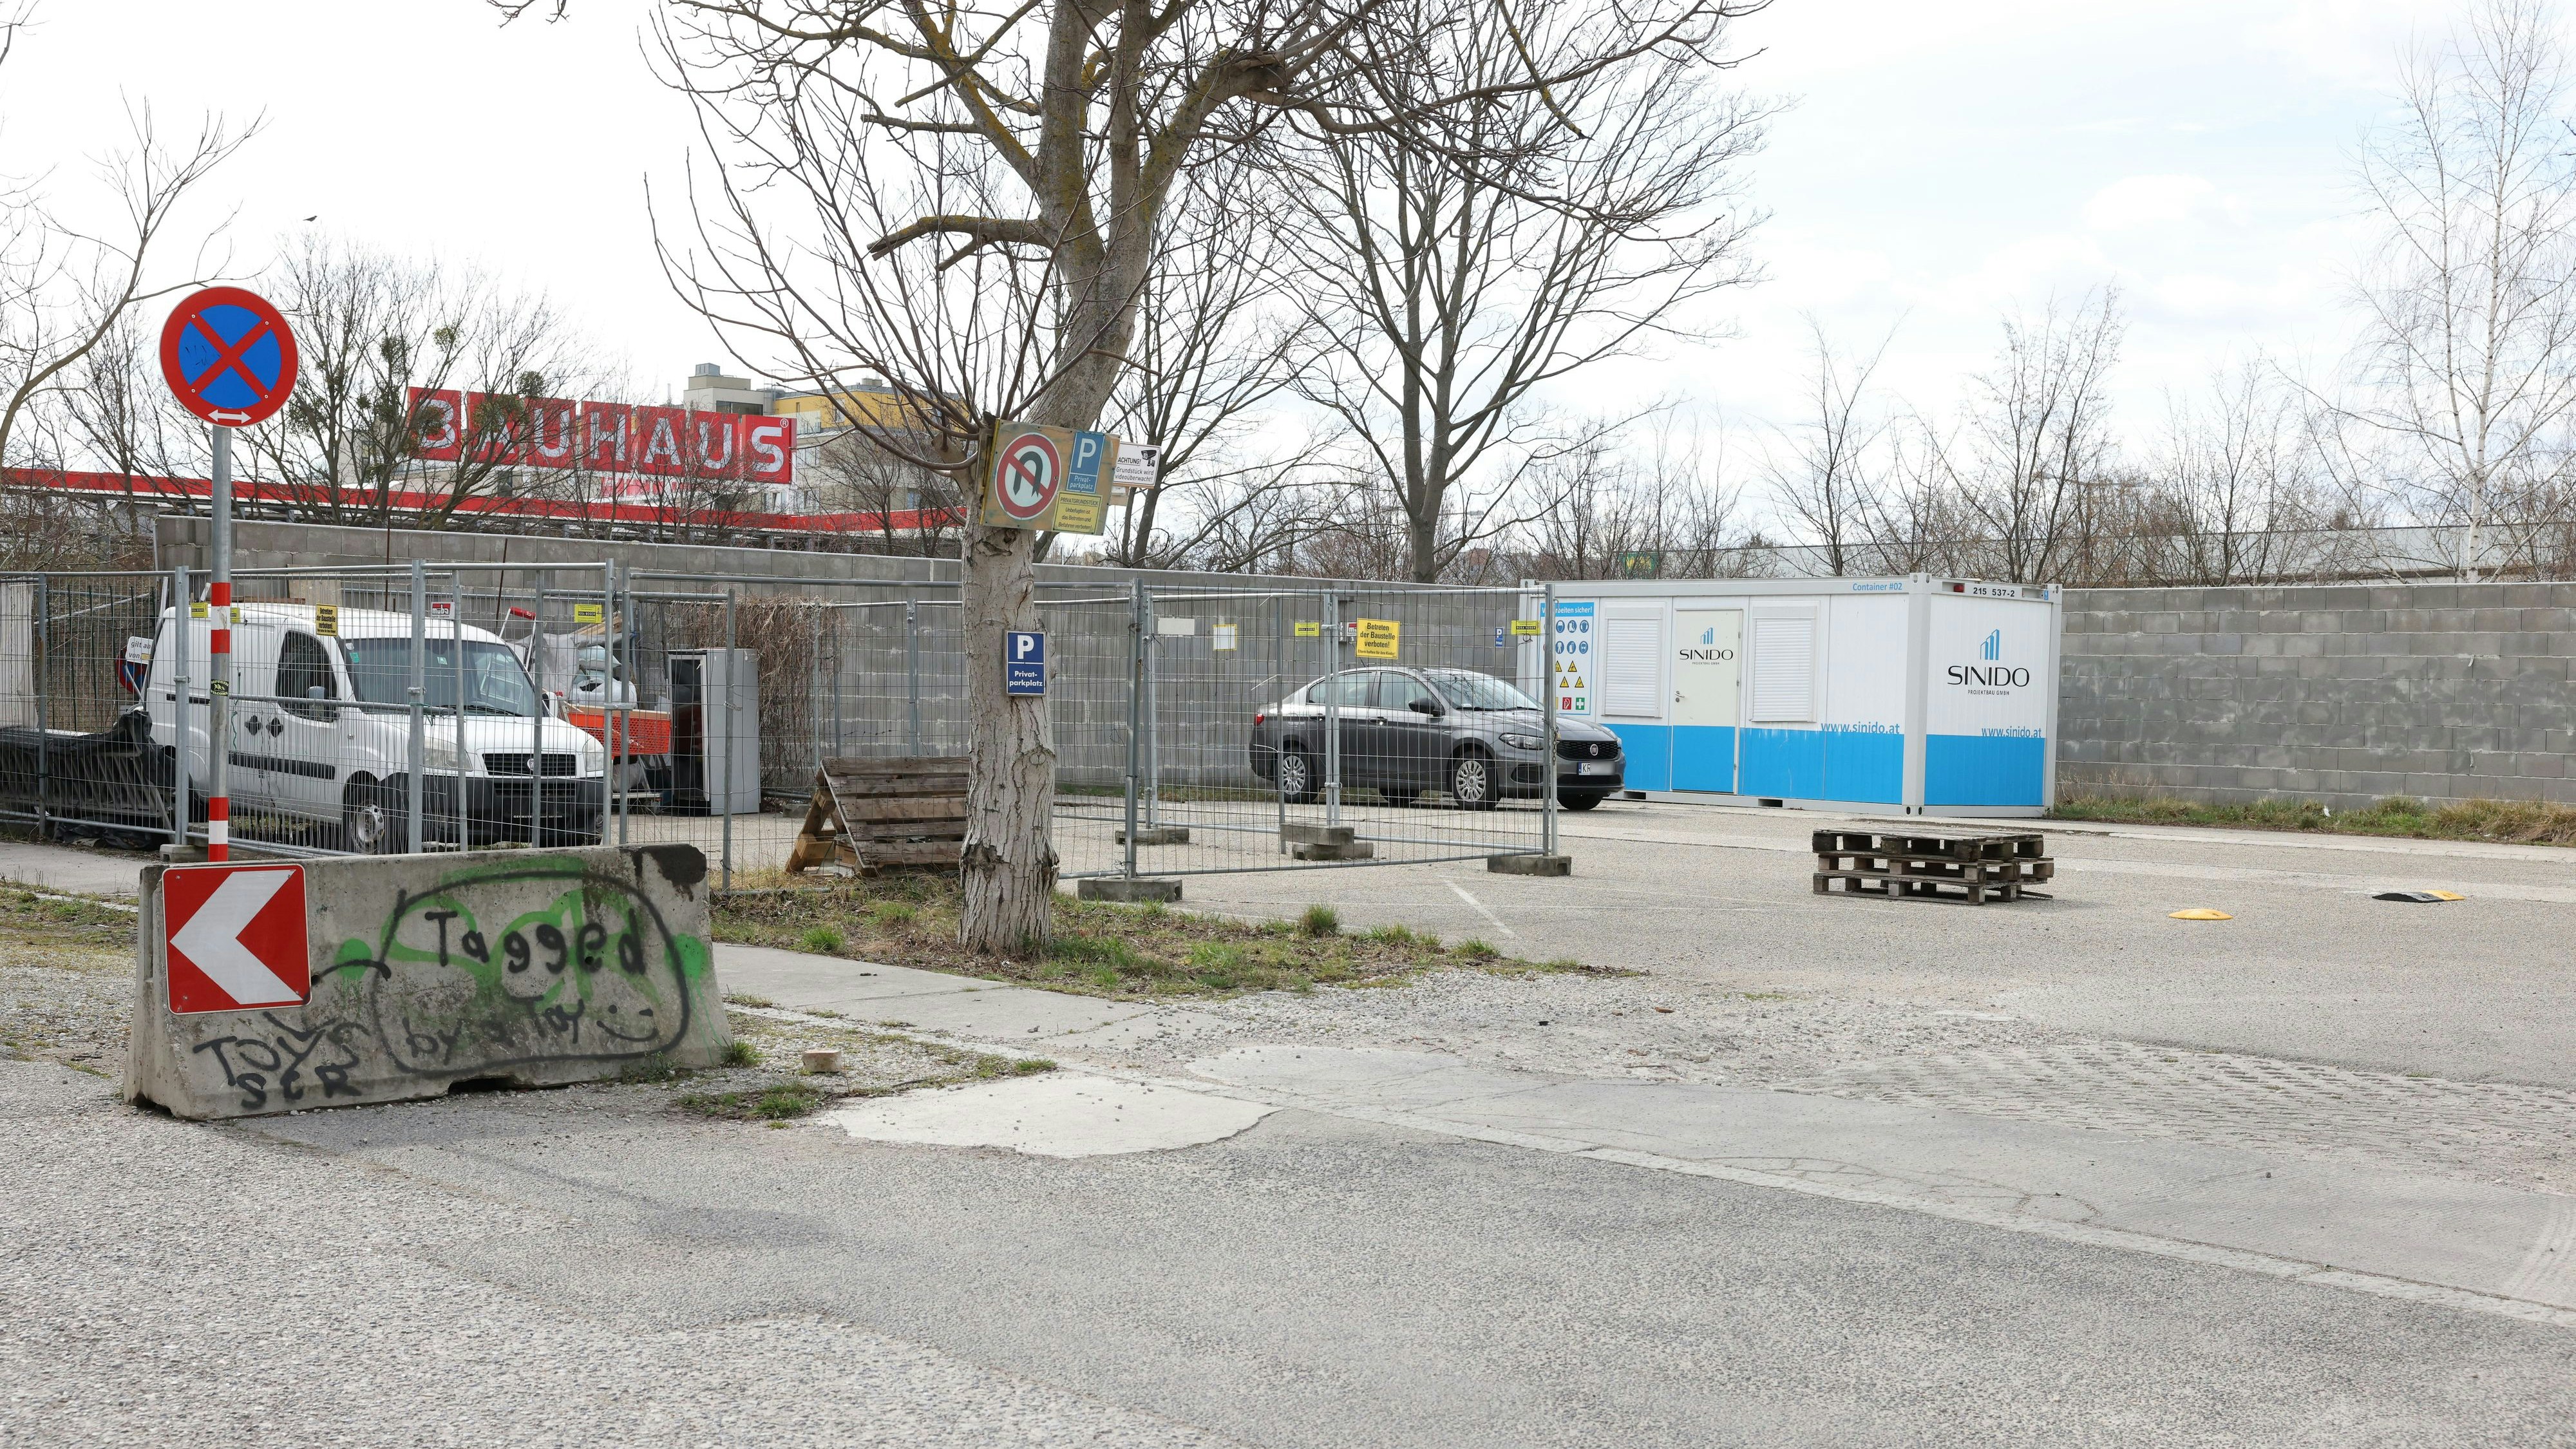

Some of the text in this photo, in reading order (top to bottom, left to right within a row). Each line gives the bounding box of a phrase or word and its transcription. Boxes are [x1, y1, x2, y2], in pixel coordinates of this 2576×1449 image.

[419, 399, 782, 473] BAUHAUS
[1077, 438, 1096, 468] P
[1070, 480, 1094, 489] parkplatz
[1060, 497, 1099, 506] PRIVATGRUNDSTÜCK
[1852, 582, 1902, 591] Container #02
[1992, 589, 2014, 597] 537-2
[432, 604, 449, 614] müba
[1367, 622, 1389, 630] Betreten
[1370, 631, 1395, 640] Baustelle
[1497, 629, 1502, 638] P
[1018, 635, 1034, 659] P
[1680, 649, 1733, 660] SINIDO
[1947, 665, 2029, 687] SINIDO
[1821, 721, 1900, 734] www.sinido.at
[1982, 726, 2041, 737] www.sinido.at
[424, 908, 645, 974] Tagged
